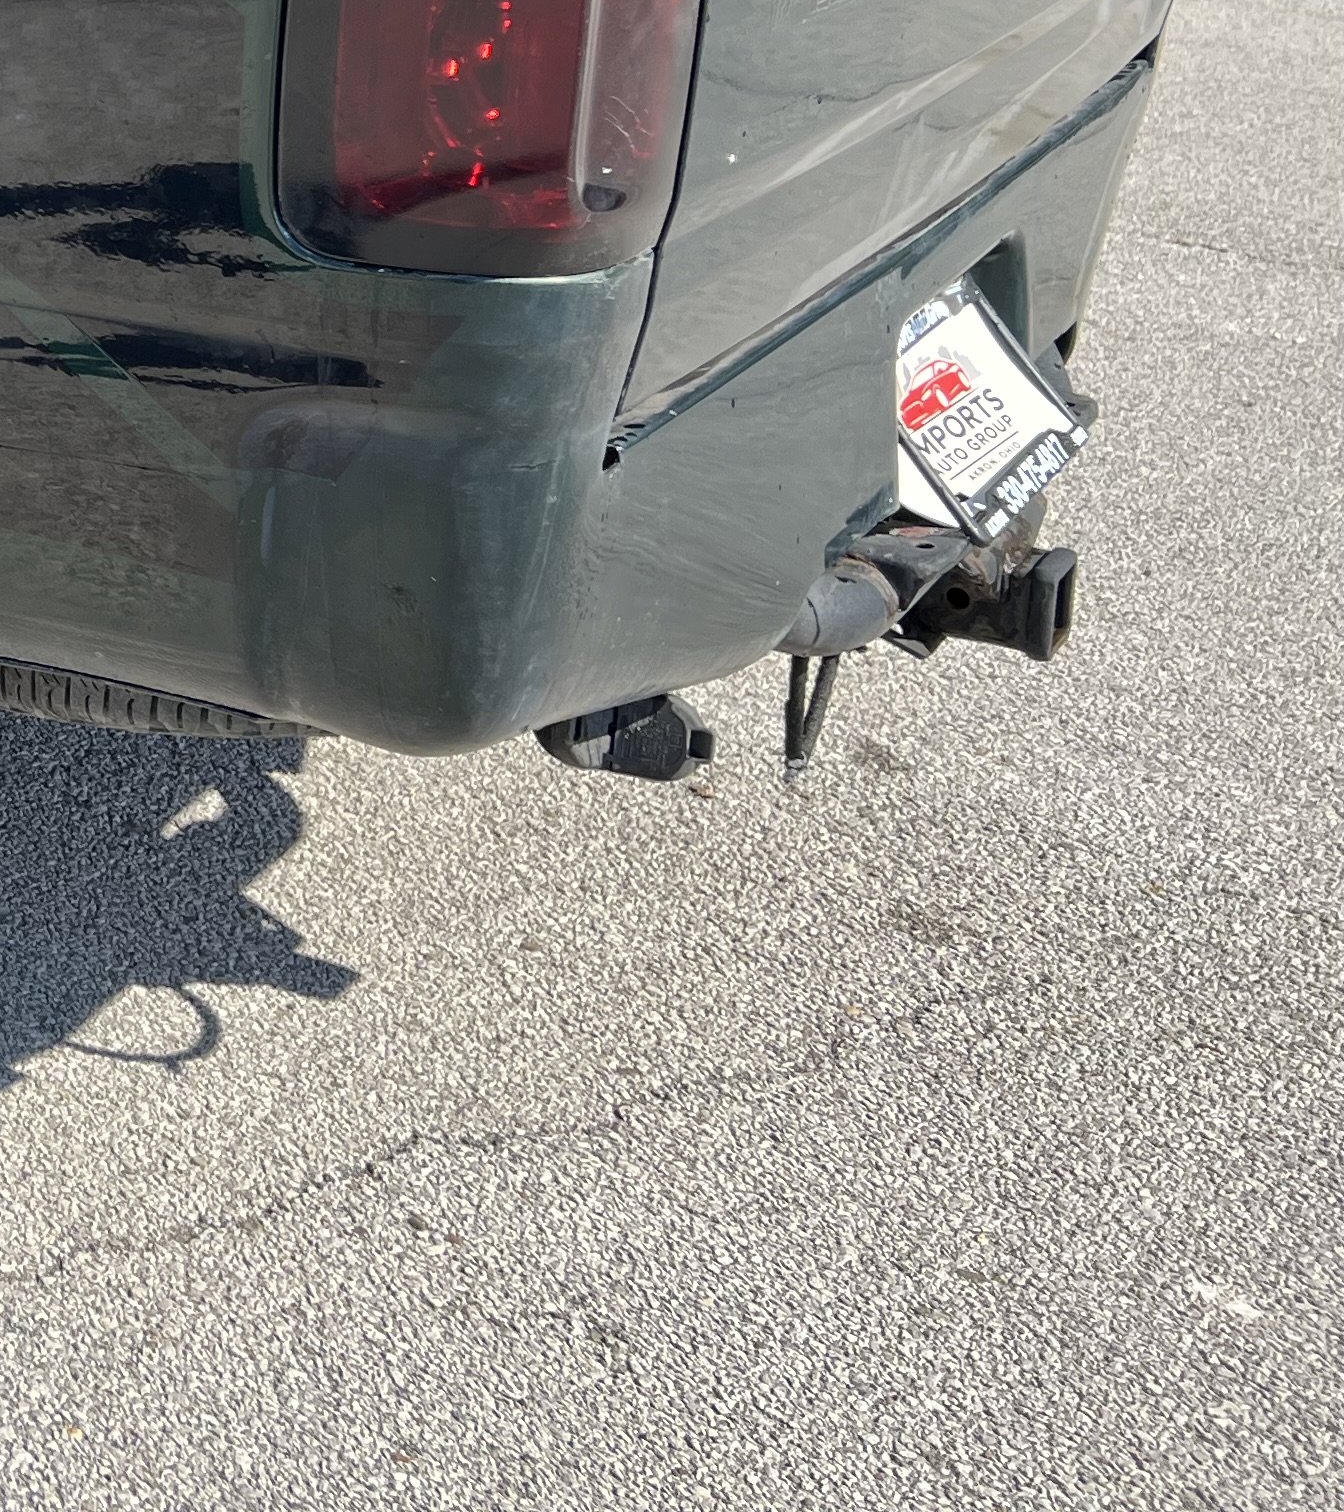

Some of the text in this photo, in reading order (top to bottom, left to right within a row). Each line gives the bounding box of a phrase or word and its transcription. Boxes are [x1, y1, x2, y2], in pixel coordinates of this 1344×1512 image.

[914, 388, 1004, 455] MPORTS
[967, 414, 1012, 451] GROUP
[998, 441, 1021, 459] OHIO
